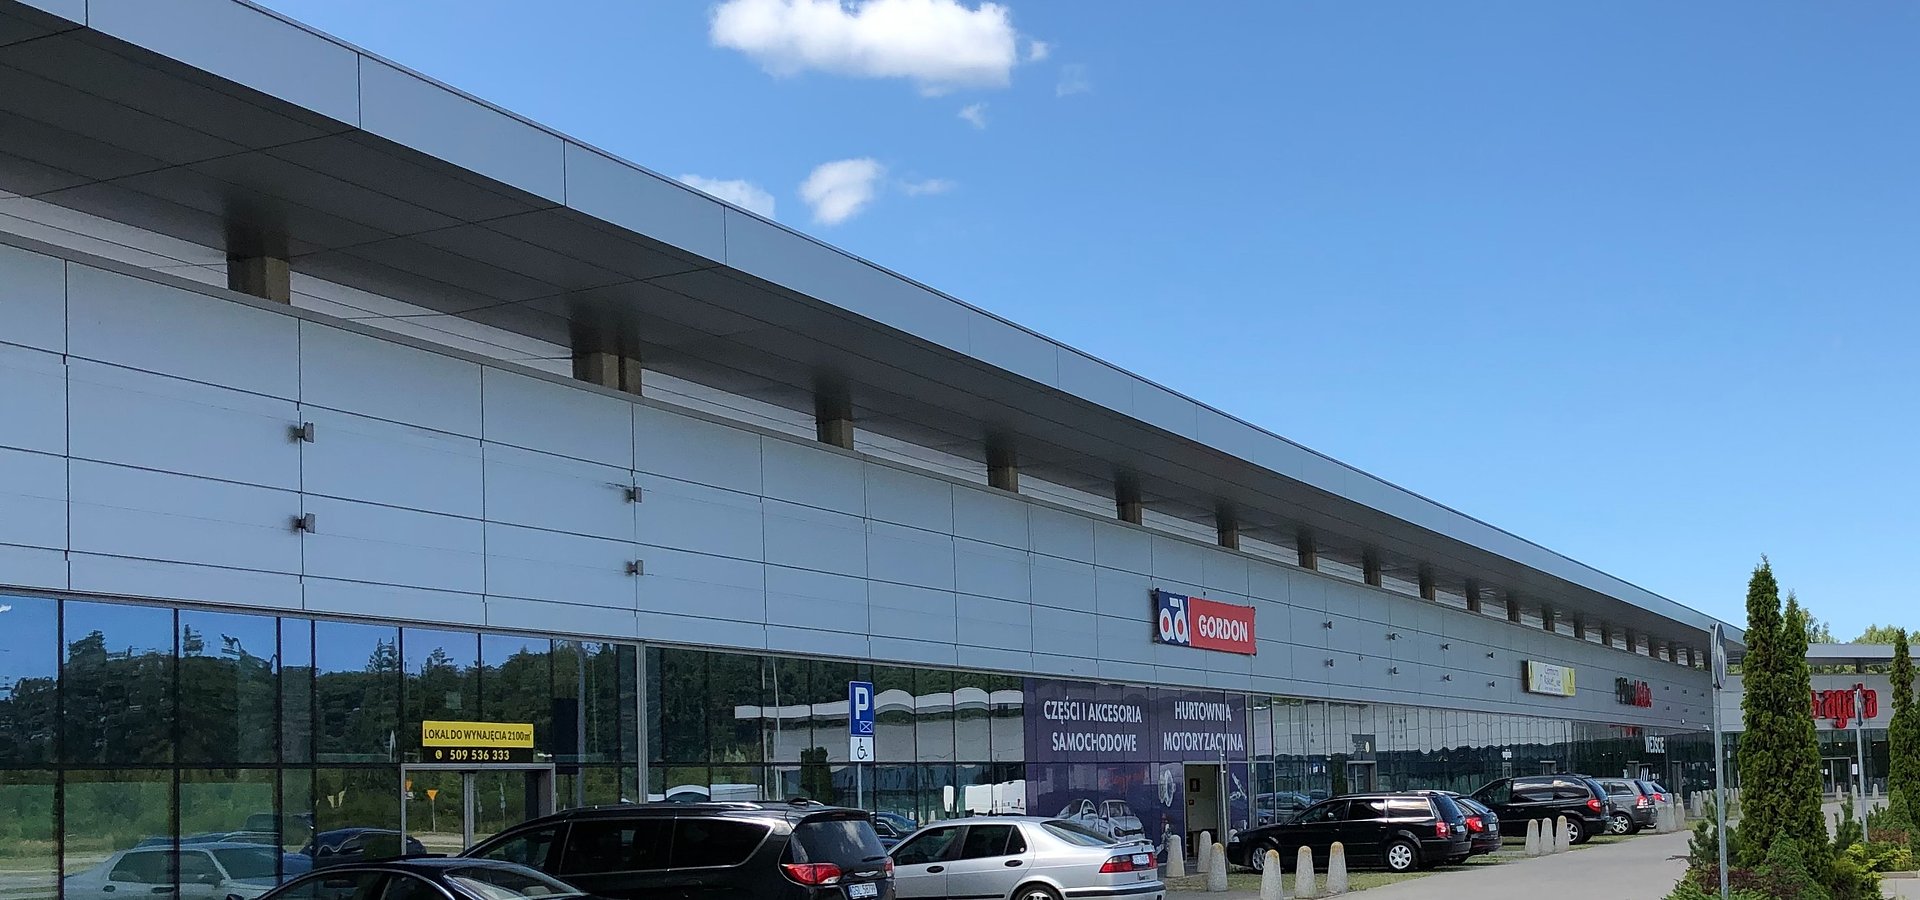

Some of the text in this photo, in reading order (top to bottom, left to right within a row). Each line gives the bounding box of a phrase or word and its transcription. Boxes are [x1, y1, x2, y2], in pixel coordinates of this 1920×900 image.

[1198, 614, 1248, 642] GORDON
[855, 686, 869, 720] P
[1043, 695, 1142, 724] CZĘŚCI I AKCESORIA
[1174, 701, 1232, 722] HURTOWNIA
[424, 728, 450, 740] LOKAL
[450, 729, 463, 740] DO
[463, 729, 507, 742] WYNAJĘCIA
[1052, 732, 1137, 752] SAMOCHODOWE
[1163, 732, 1244, 752] MOTORYZACYJNA
[450, 749, 510, 760] 509 536 333
